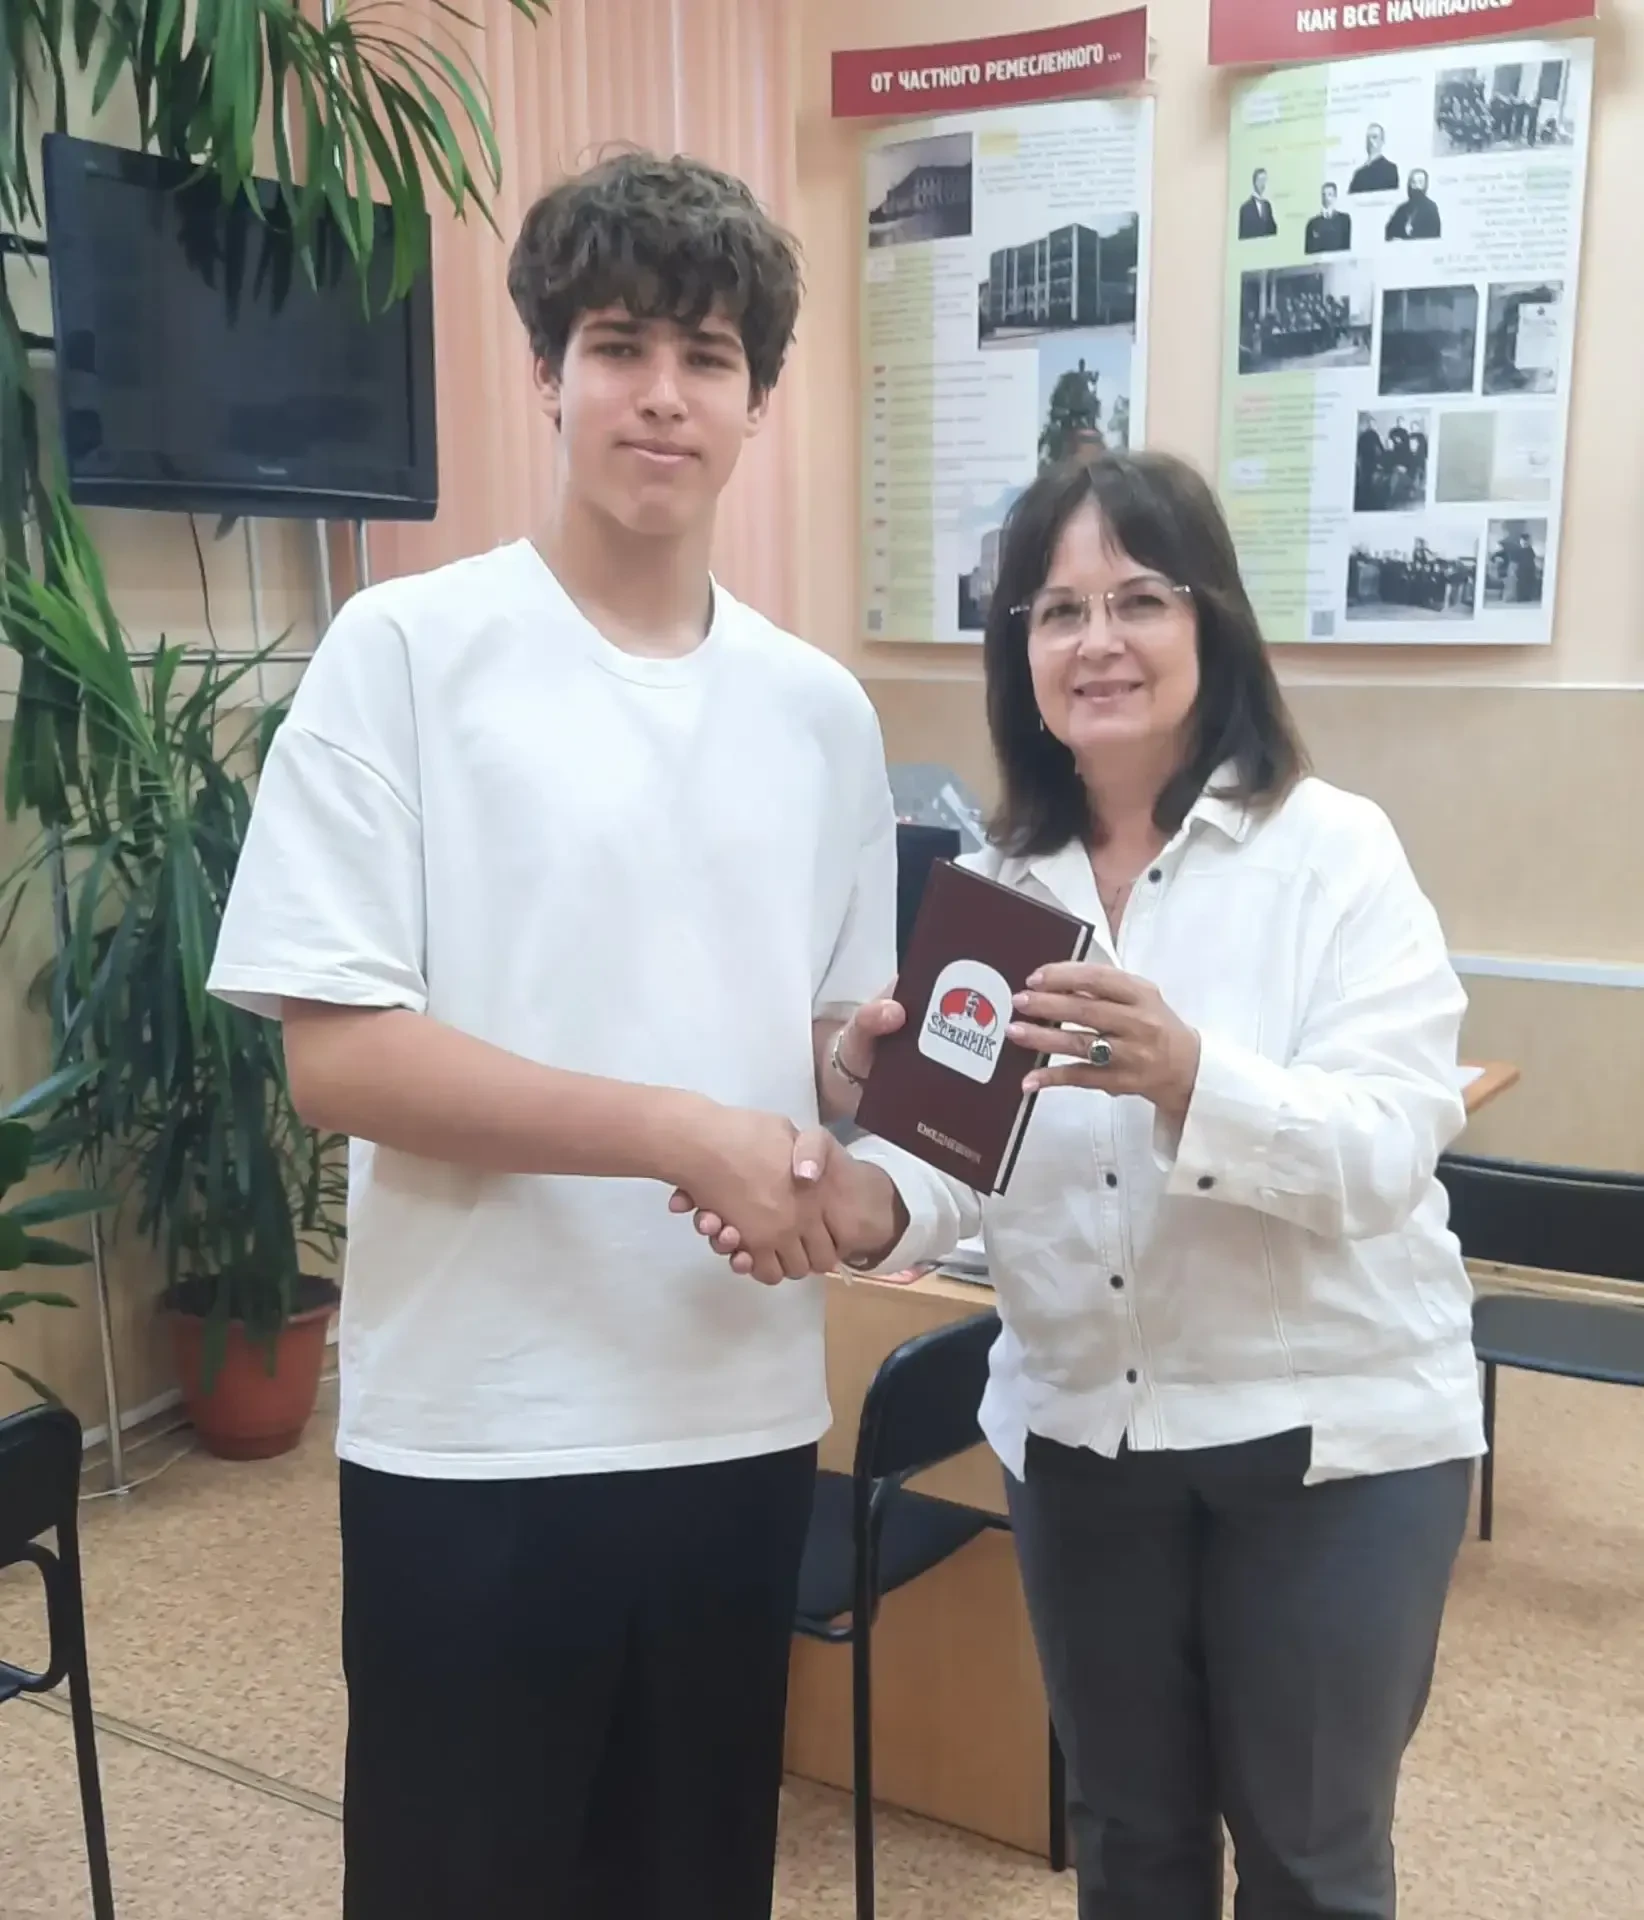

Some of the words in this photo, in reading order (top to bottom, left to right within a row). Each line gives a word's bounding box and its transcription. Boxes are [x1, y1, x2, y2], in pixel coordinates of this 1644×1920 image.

[1297, 7, 1337, 33] КАК
[1343, 3, 1381, 29] ВСЕ
[1386, 0, 1514, 23] НАЧИНАЛ
[870, 71, 896, 93] ОТ
[898, 63, 981, 91] ЧАСТНОГО
[985, 43, 1104, 82] РЕМЕСЛЕННОГО
